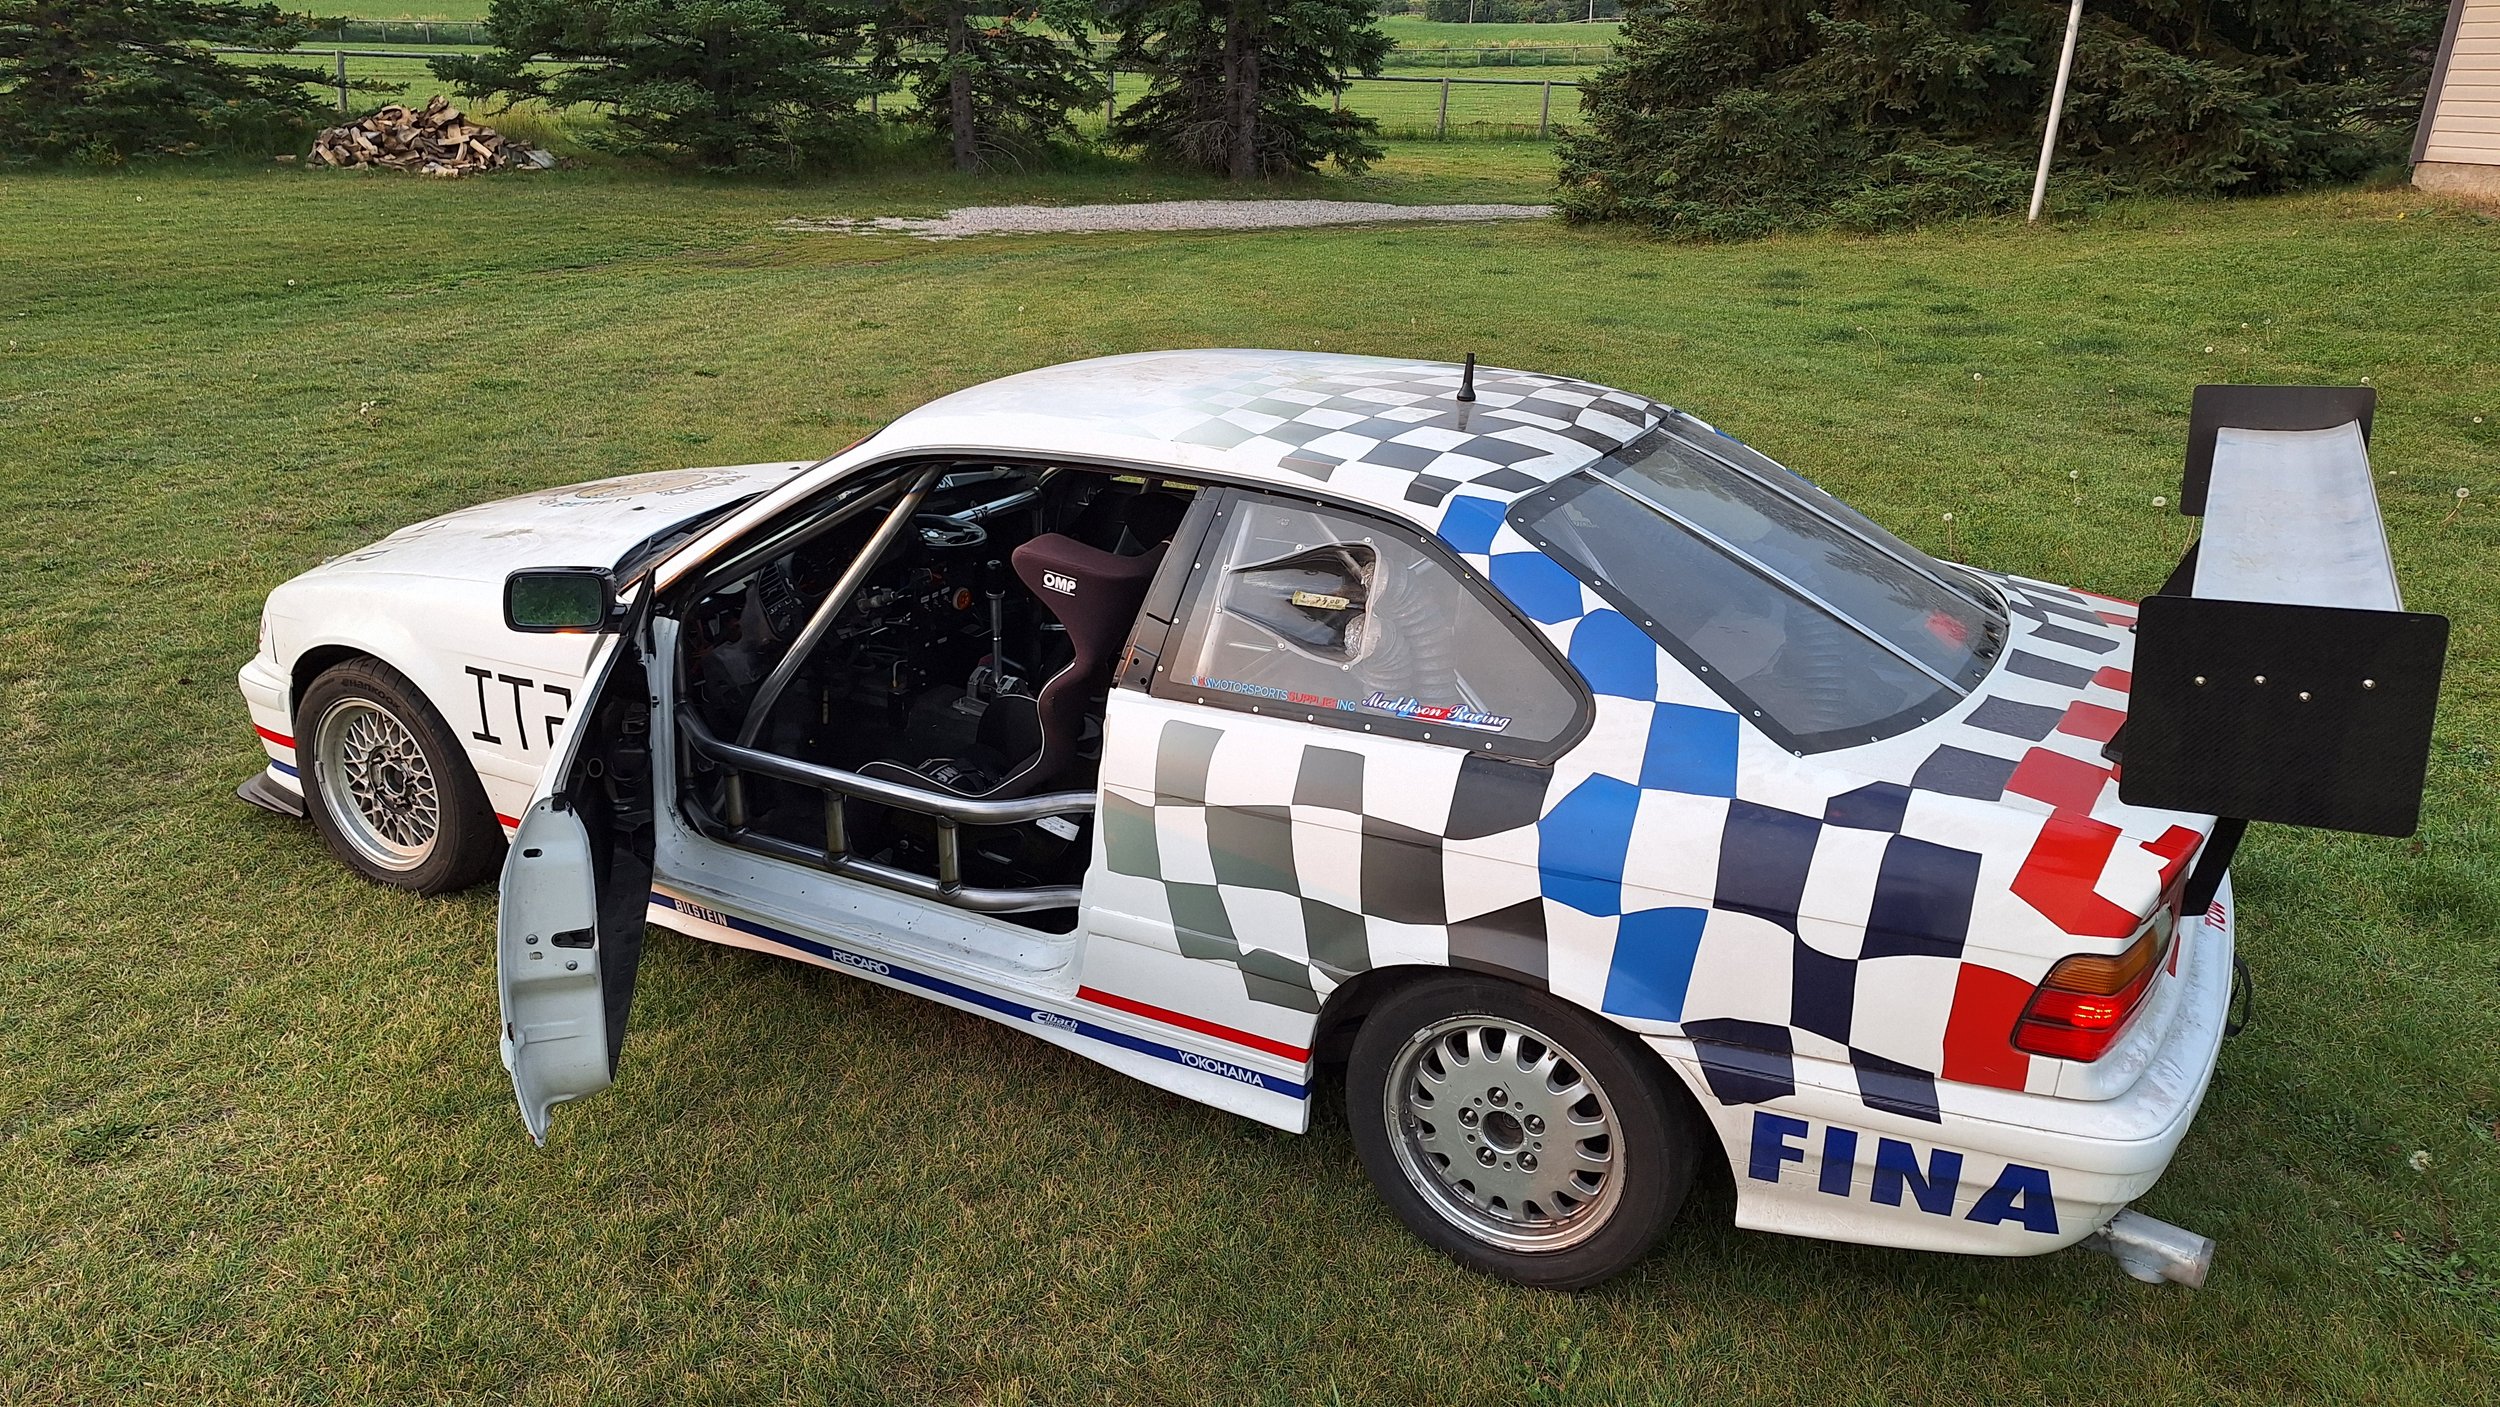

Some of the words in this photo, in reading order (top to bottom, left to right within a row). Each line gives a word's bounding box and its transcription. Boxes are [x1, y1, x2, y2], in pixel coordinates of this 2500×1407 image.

[1043, 573, 1077, 593] OMP
[1362, 691, 1444, 718] Maddison
[1447, 704, 1513, 730] Racing
[674, 899, 728, 927] BILSTEIN
[831, 948, 890, 976] RECARO
[1177, 1050, 1265, 1088] YOKOHAMA
[1748, 1110, 2060, 1235] FINA
